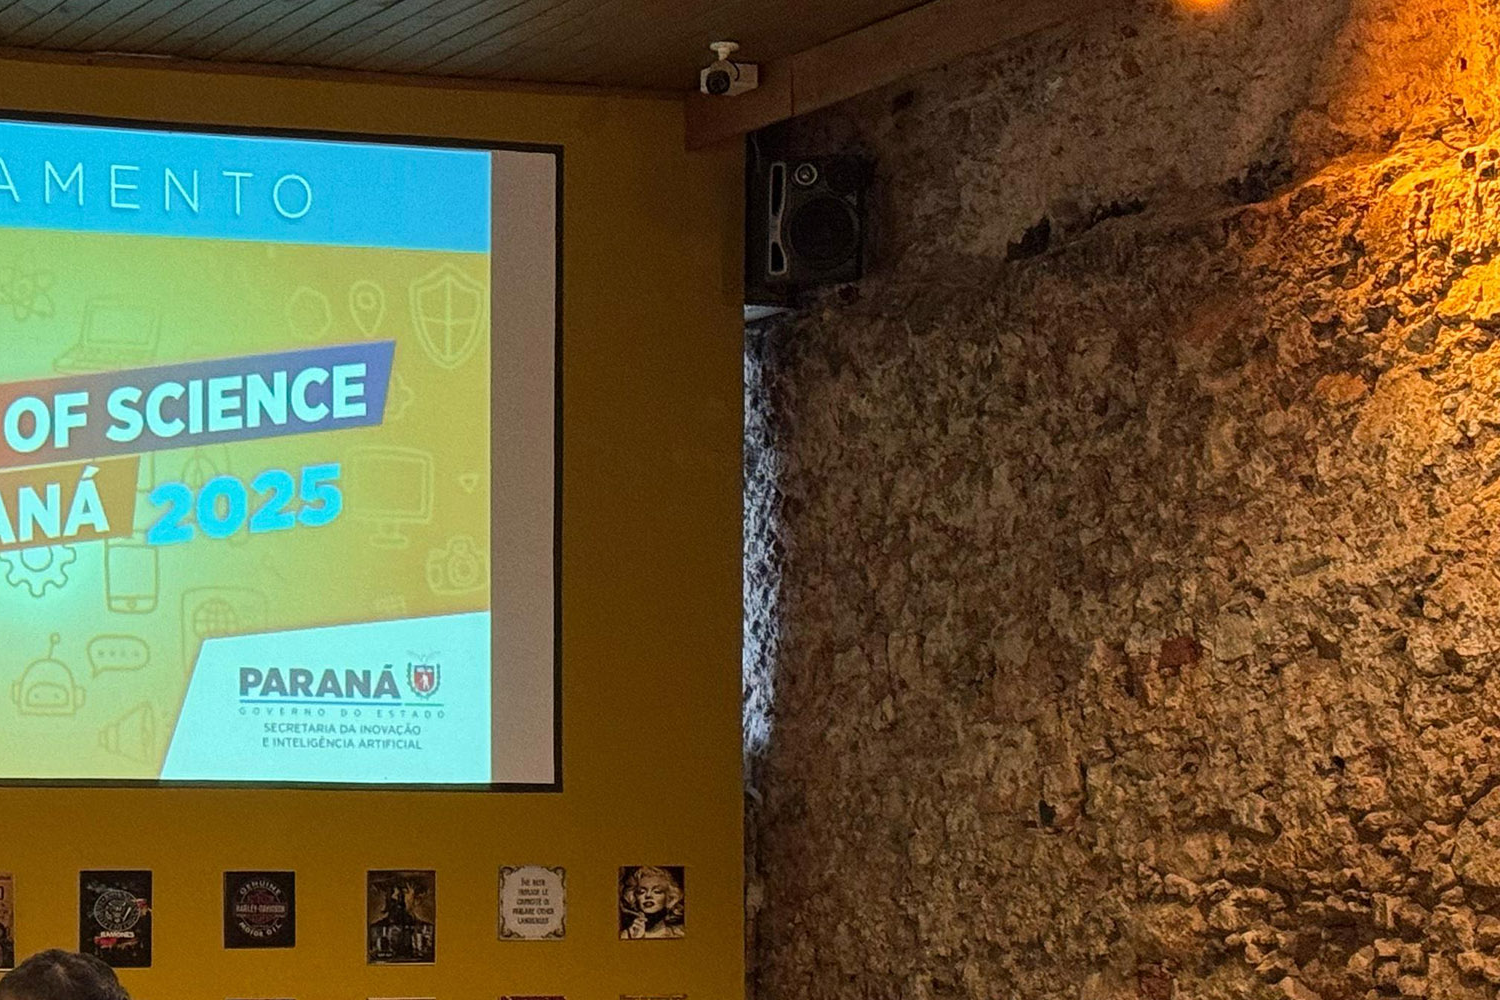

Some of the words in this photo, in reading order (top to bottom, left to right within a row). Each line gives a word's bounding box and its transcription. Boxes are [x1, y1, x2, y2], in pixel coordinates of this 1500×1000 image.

[3, 391, 90, 453] OF
[105, 362, 368, 444] SCIENCE
[146, 463, 344, 546] 2025
[239, 663, 402, 699] PARANÁ
[238, 707, 326, 717] GOVERNO
[340, 708, 362, 718] DO
[377, 709, 446, 720] ESTADO
[263, 722, 337, 734] SECRETARIA
[339, 723, 357, 735] DA
[359, 724, 422, 737] INOVAÇÃO
[262, 737, 270, 748] E
[272, 735, 355, 749] INTELIGÊNCIA
[358, 738, 423, 750] ARTIFICIAL
